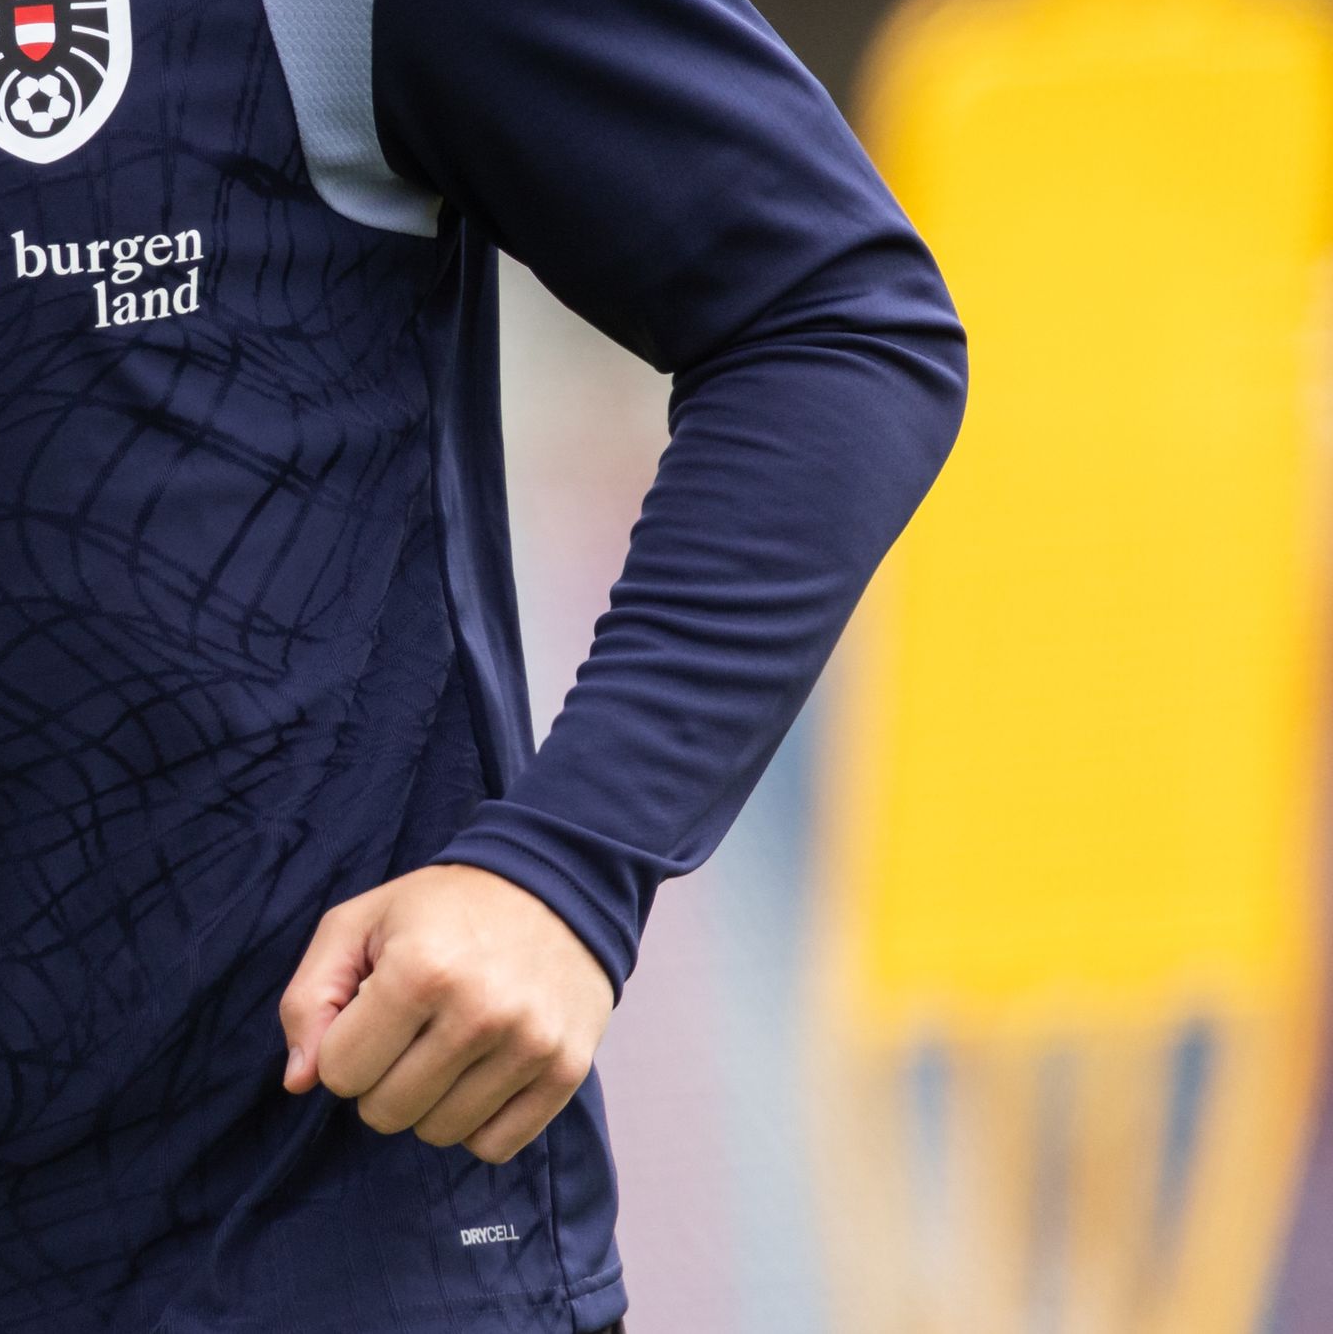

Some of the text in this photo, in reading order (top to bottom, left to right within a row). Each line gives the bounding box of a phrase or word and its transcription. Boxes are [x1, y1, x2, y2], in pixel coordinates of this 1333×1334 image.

[11, 228, 204, 285] burgen
[93, 266, 200, 328] land
[460, 1224, 520, 1246] DRYCELL
